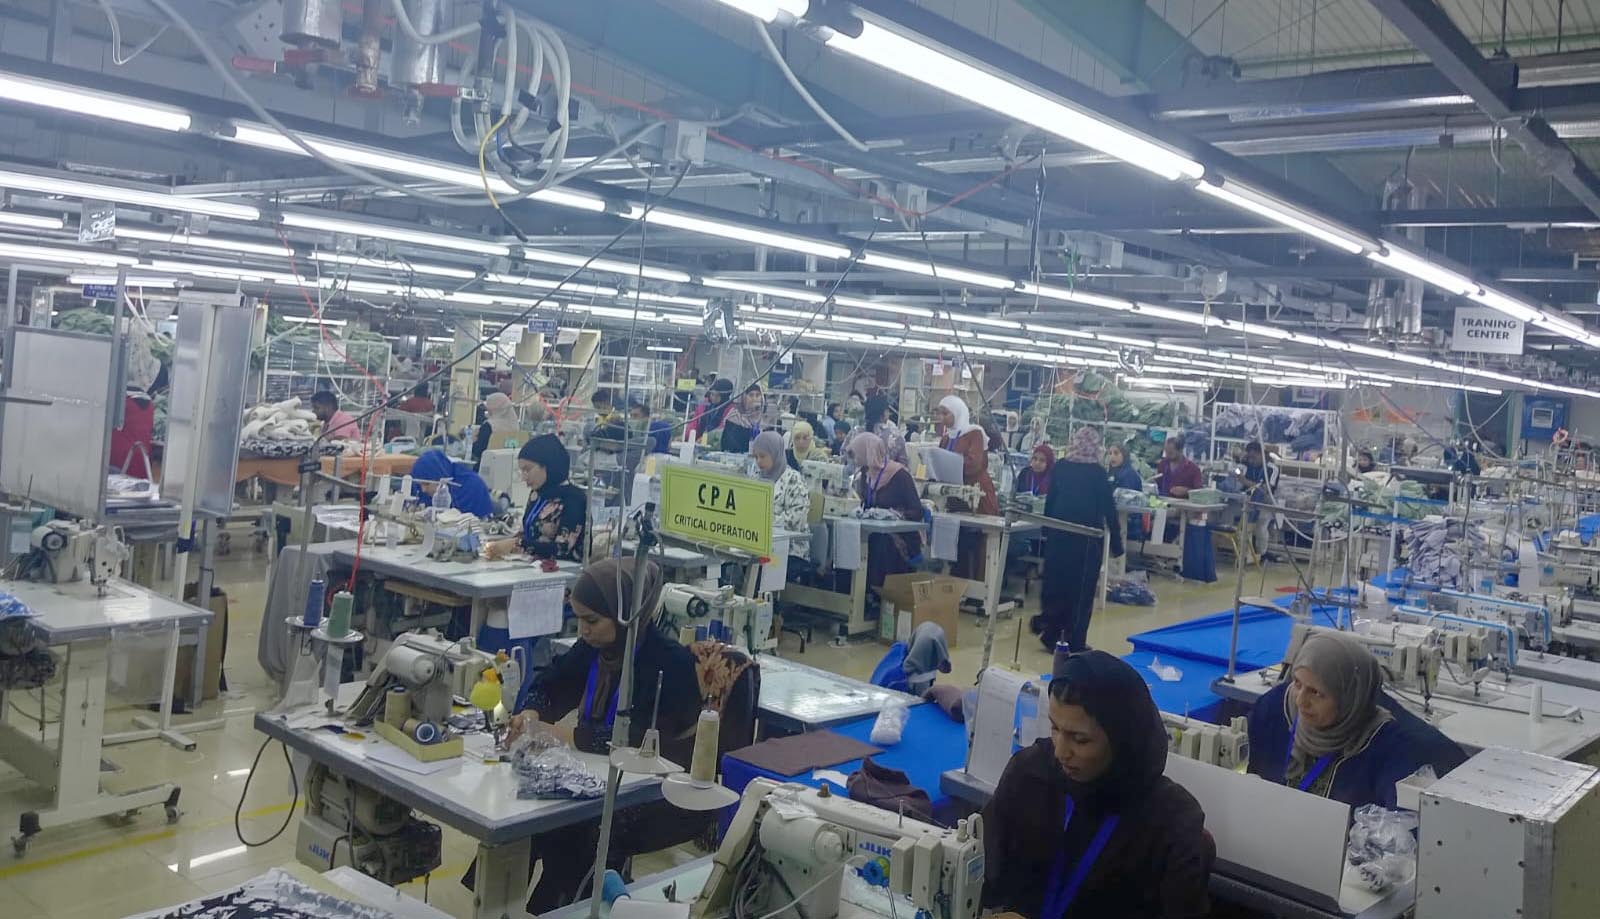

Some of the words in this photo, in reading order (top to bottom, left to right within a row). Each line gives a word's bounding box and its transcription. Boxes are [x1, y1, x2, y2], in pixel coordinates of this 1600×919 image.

[1462, 318, 1517, 329] TRANING
[1467, 329, 1510, 340] CENTER
[674, 513, 709, 531] CRITICAL
[709, 521, 759, 542] OPERATION
[859, 842, 892, 857] JUK
